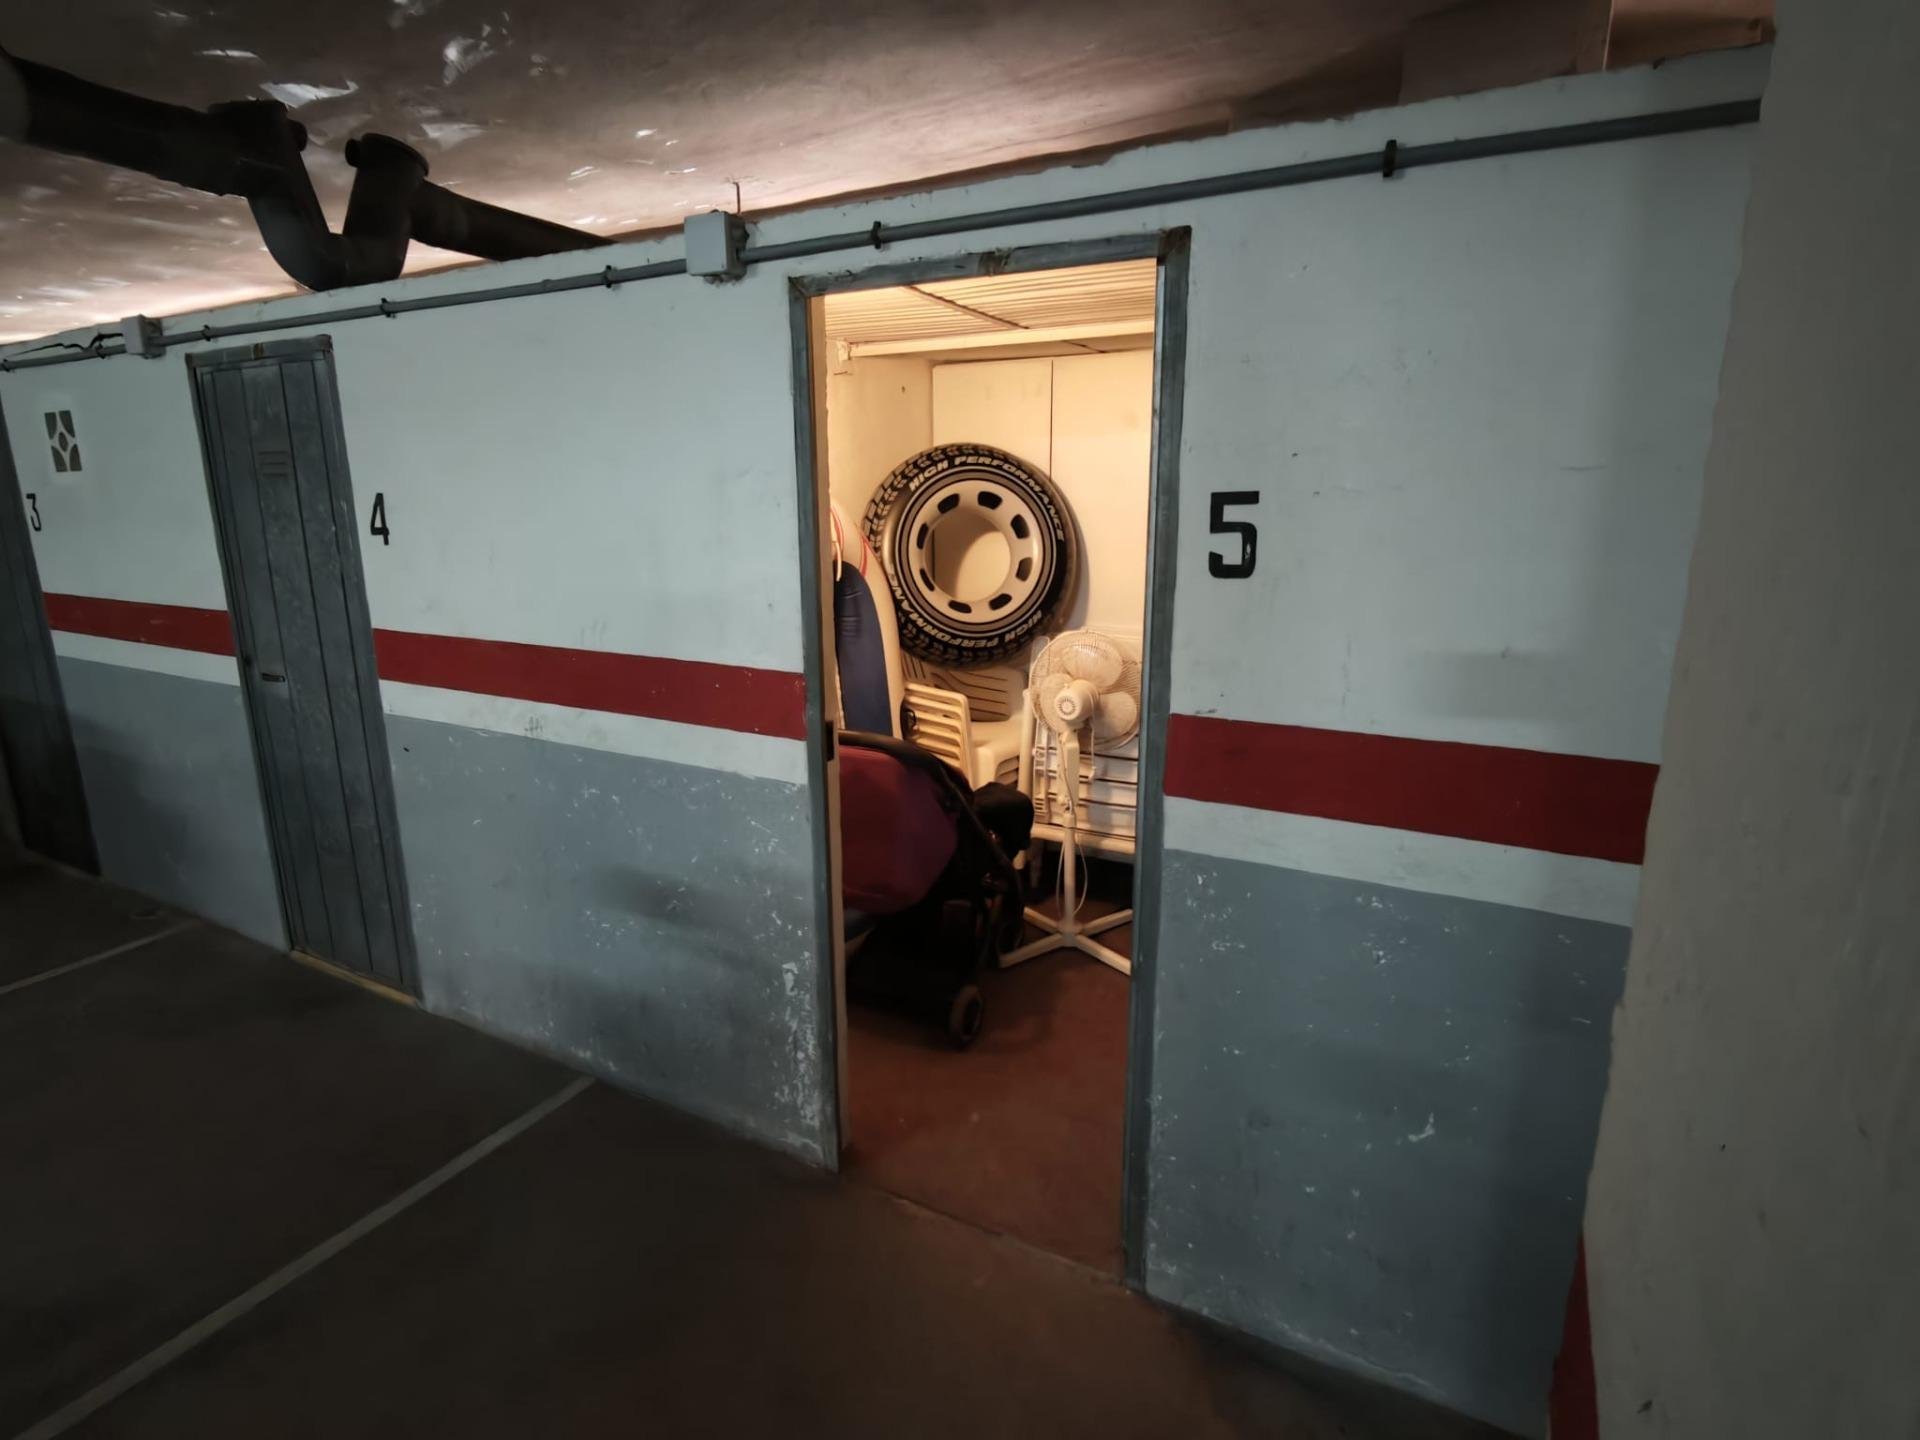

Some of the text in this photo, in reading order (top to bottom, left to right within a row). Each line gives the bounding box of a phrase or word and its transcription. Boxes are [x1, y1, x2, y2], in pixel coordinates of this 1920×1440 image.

[26, 493, 42, 532] 3
[370, 492, 390, 546] 4
[909, 455, 1065, 542] HIGH PERFORMANCE
[1208, 490, 1260, 579] 5
[887, 570, 1043, 648] HIGH PERFORMANC
